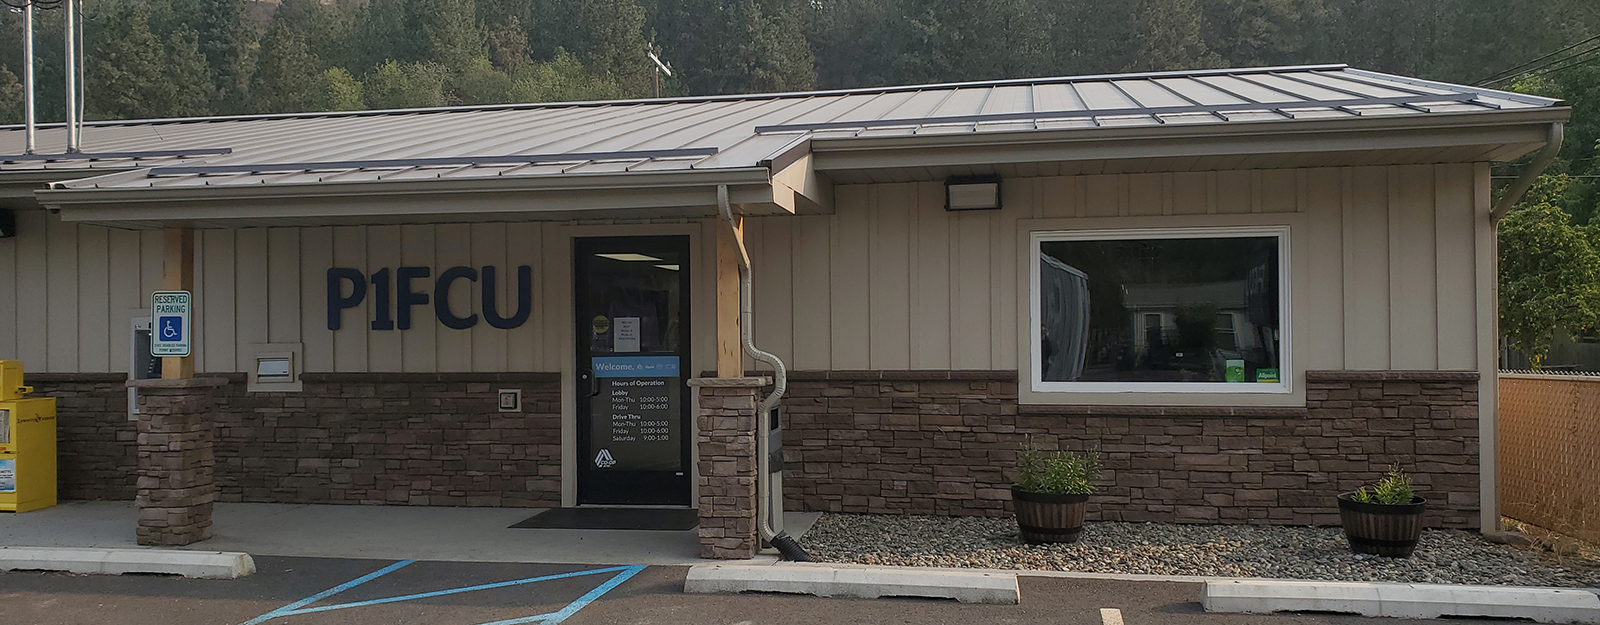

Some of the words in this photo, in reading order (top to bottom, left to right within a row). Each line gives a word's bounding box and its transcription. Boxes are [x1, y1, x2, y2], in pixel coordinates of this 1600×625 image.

[155, 295, 188, 304] RESERVED
[327, 265, 531, 331] P1FCU
[156, 305, 186, 314] PARKING
